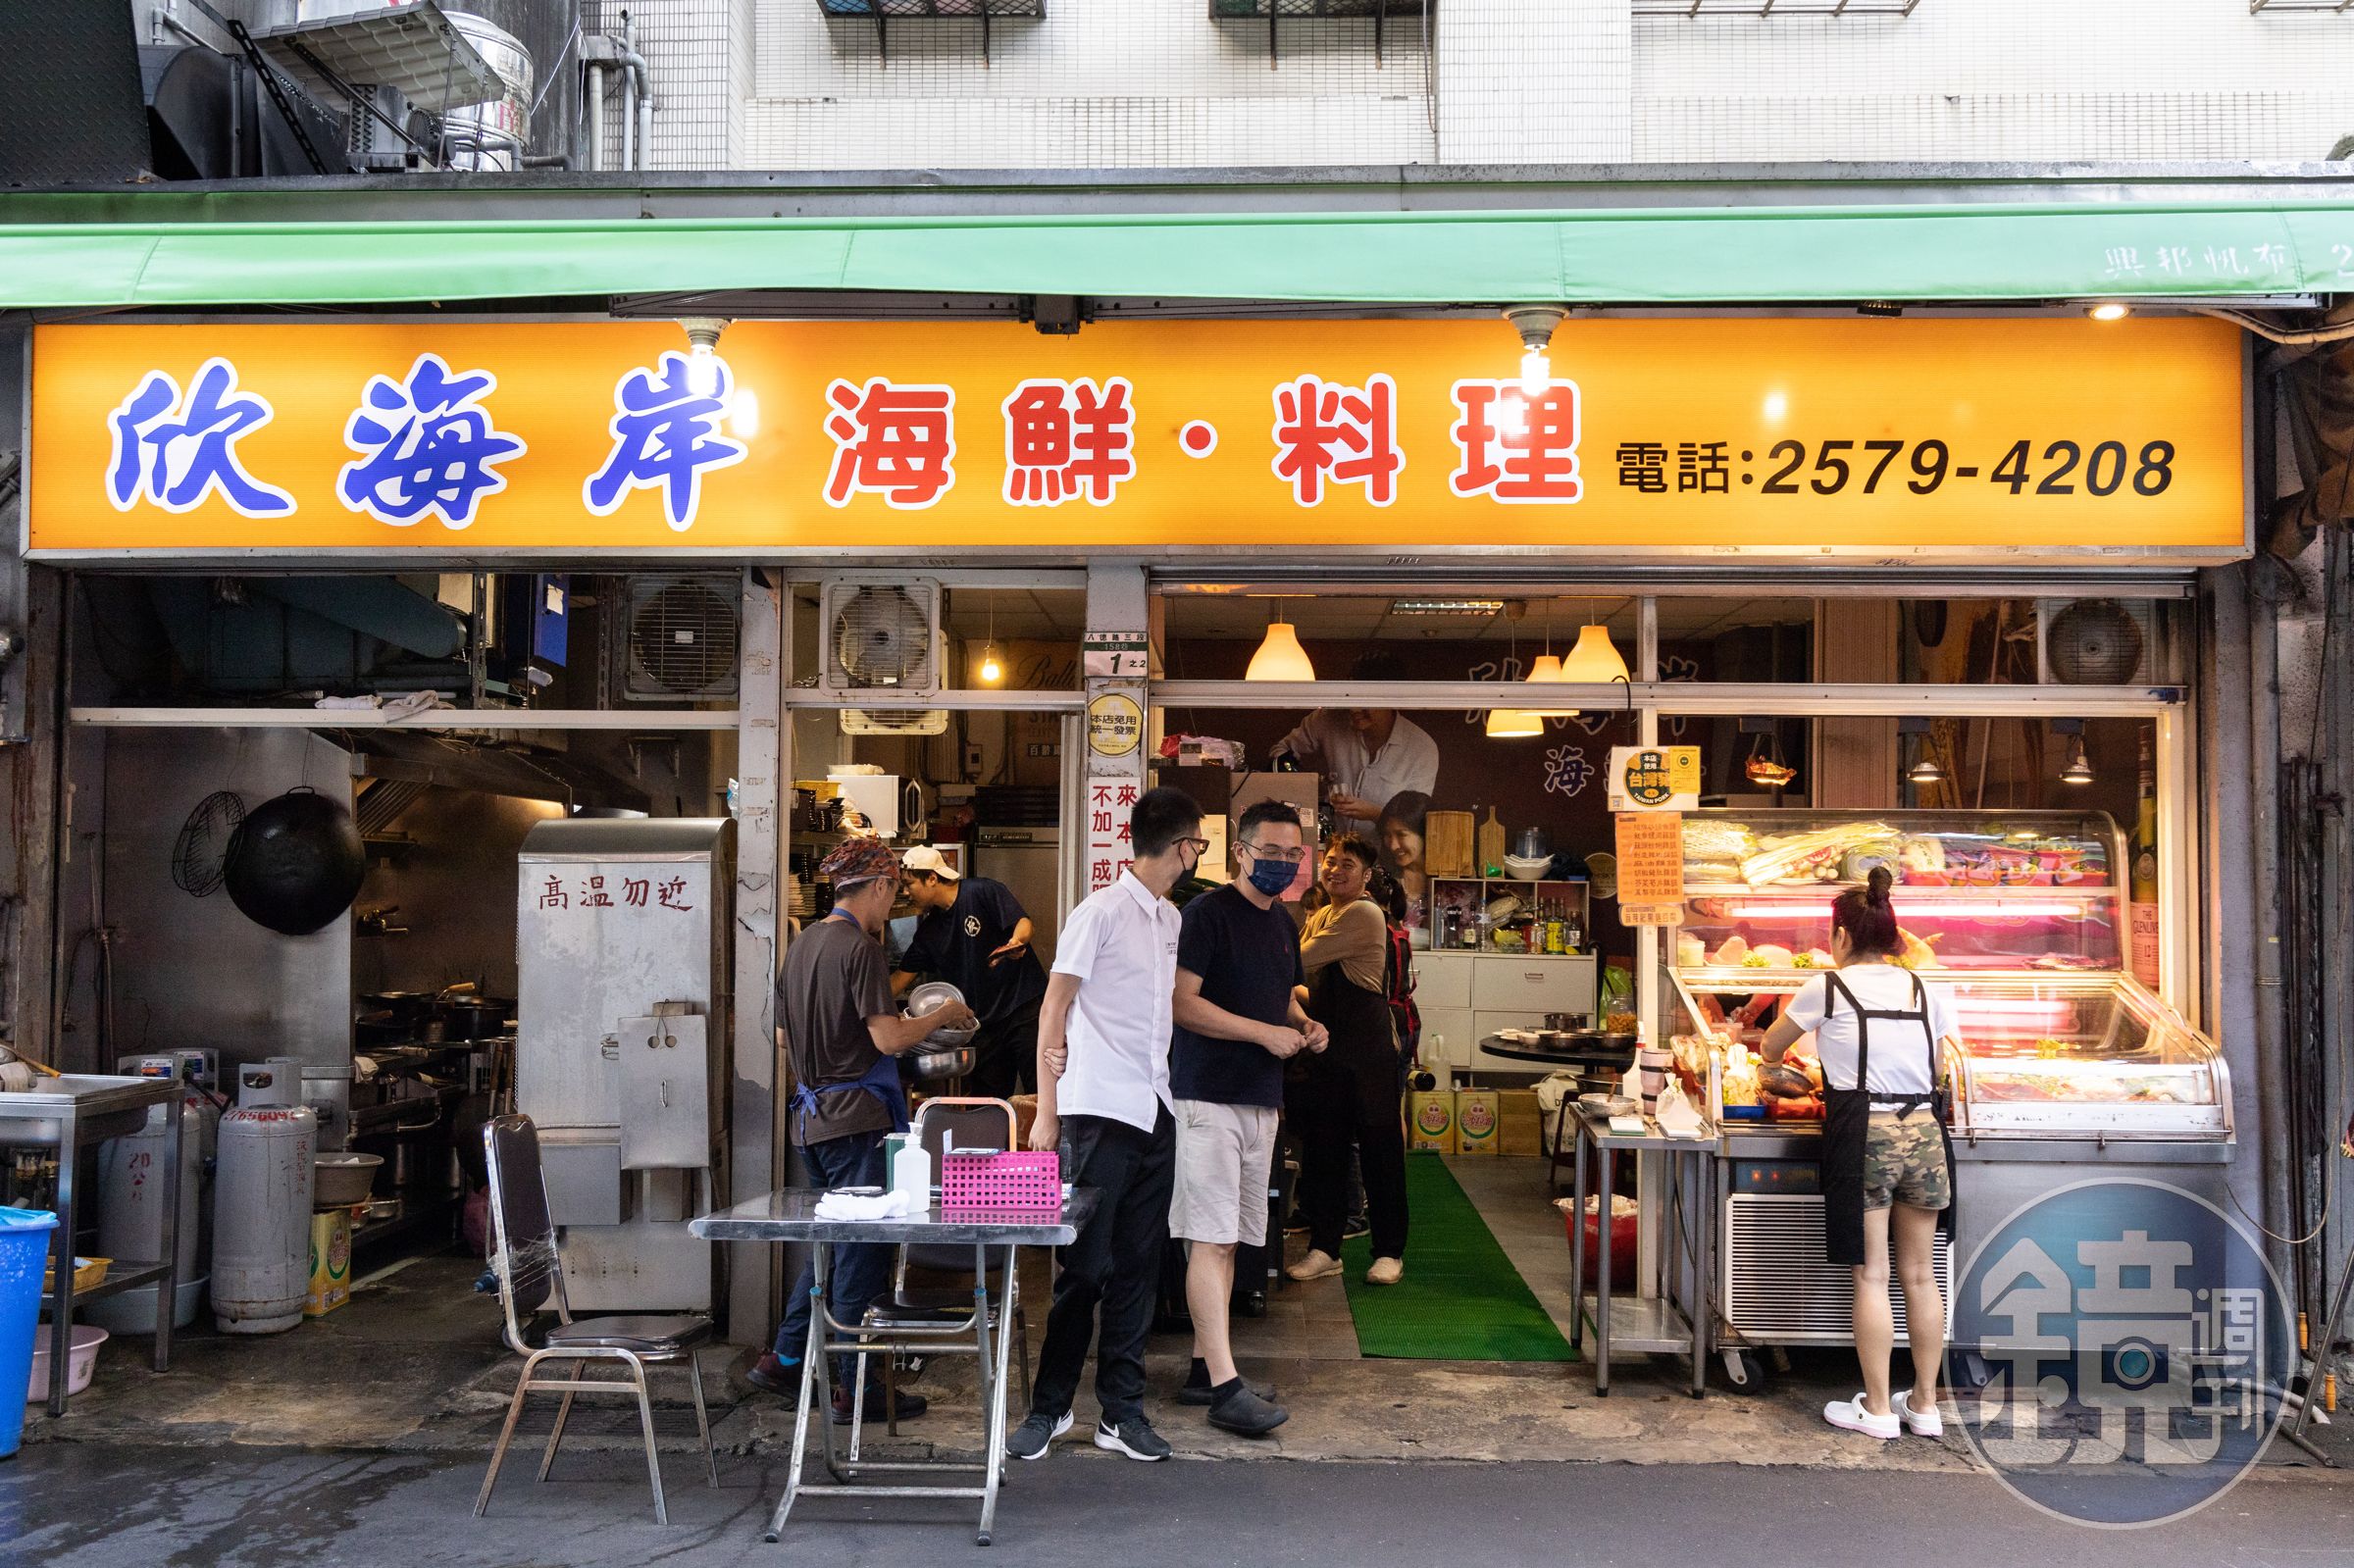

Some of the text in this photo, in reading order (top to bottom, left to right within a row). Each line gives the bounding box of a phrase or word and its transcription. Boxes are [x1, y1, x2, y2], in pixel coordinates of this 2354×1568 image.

[105, 352, 749, 532] 欣海岸
[1110, 652, 1122, 675] 1
[1090, 715, 1137, 725] 本店免用
[1090, 725, 1137, 735] 統一發票
[1633, 791, 1654, 804] TAIWAN
[2132, 920, 2159, 935] GLENLIVE
